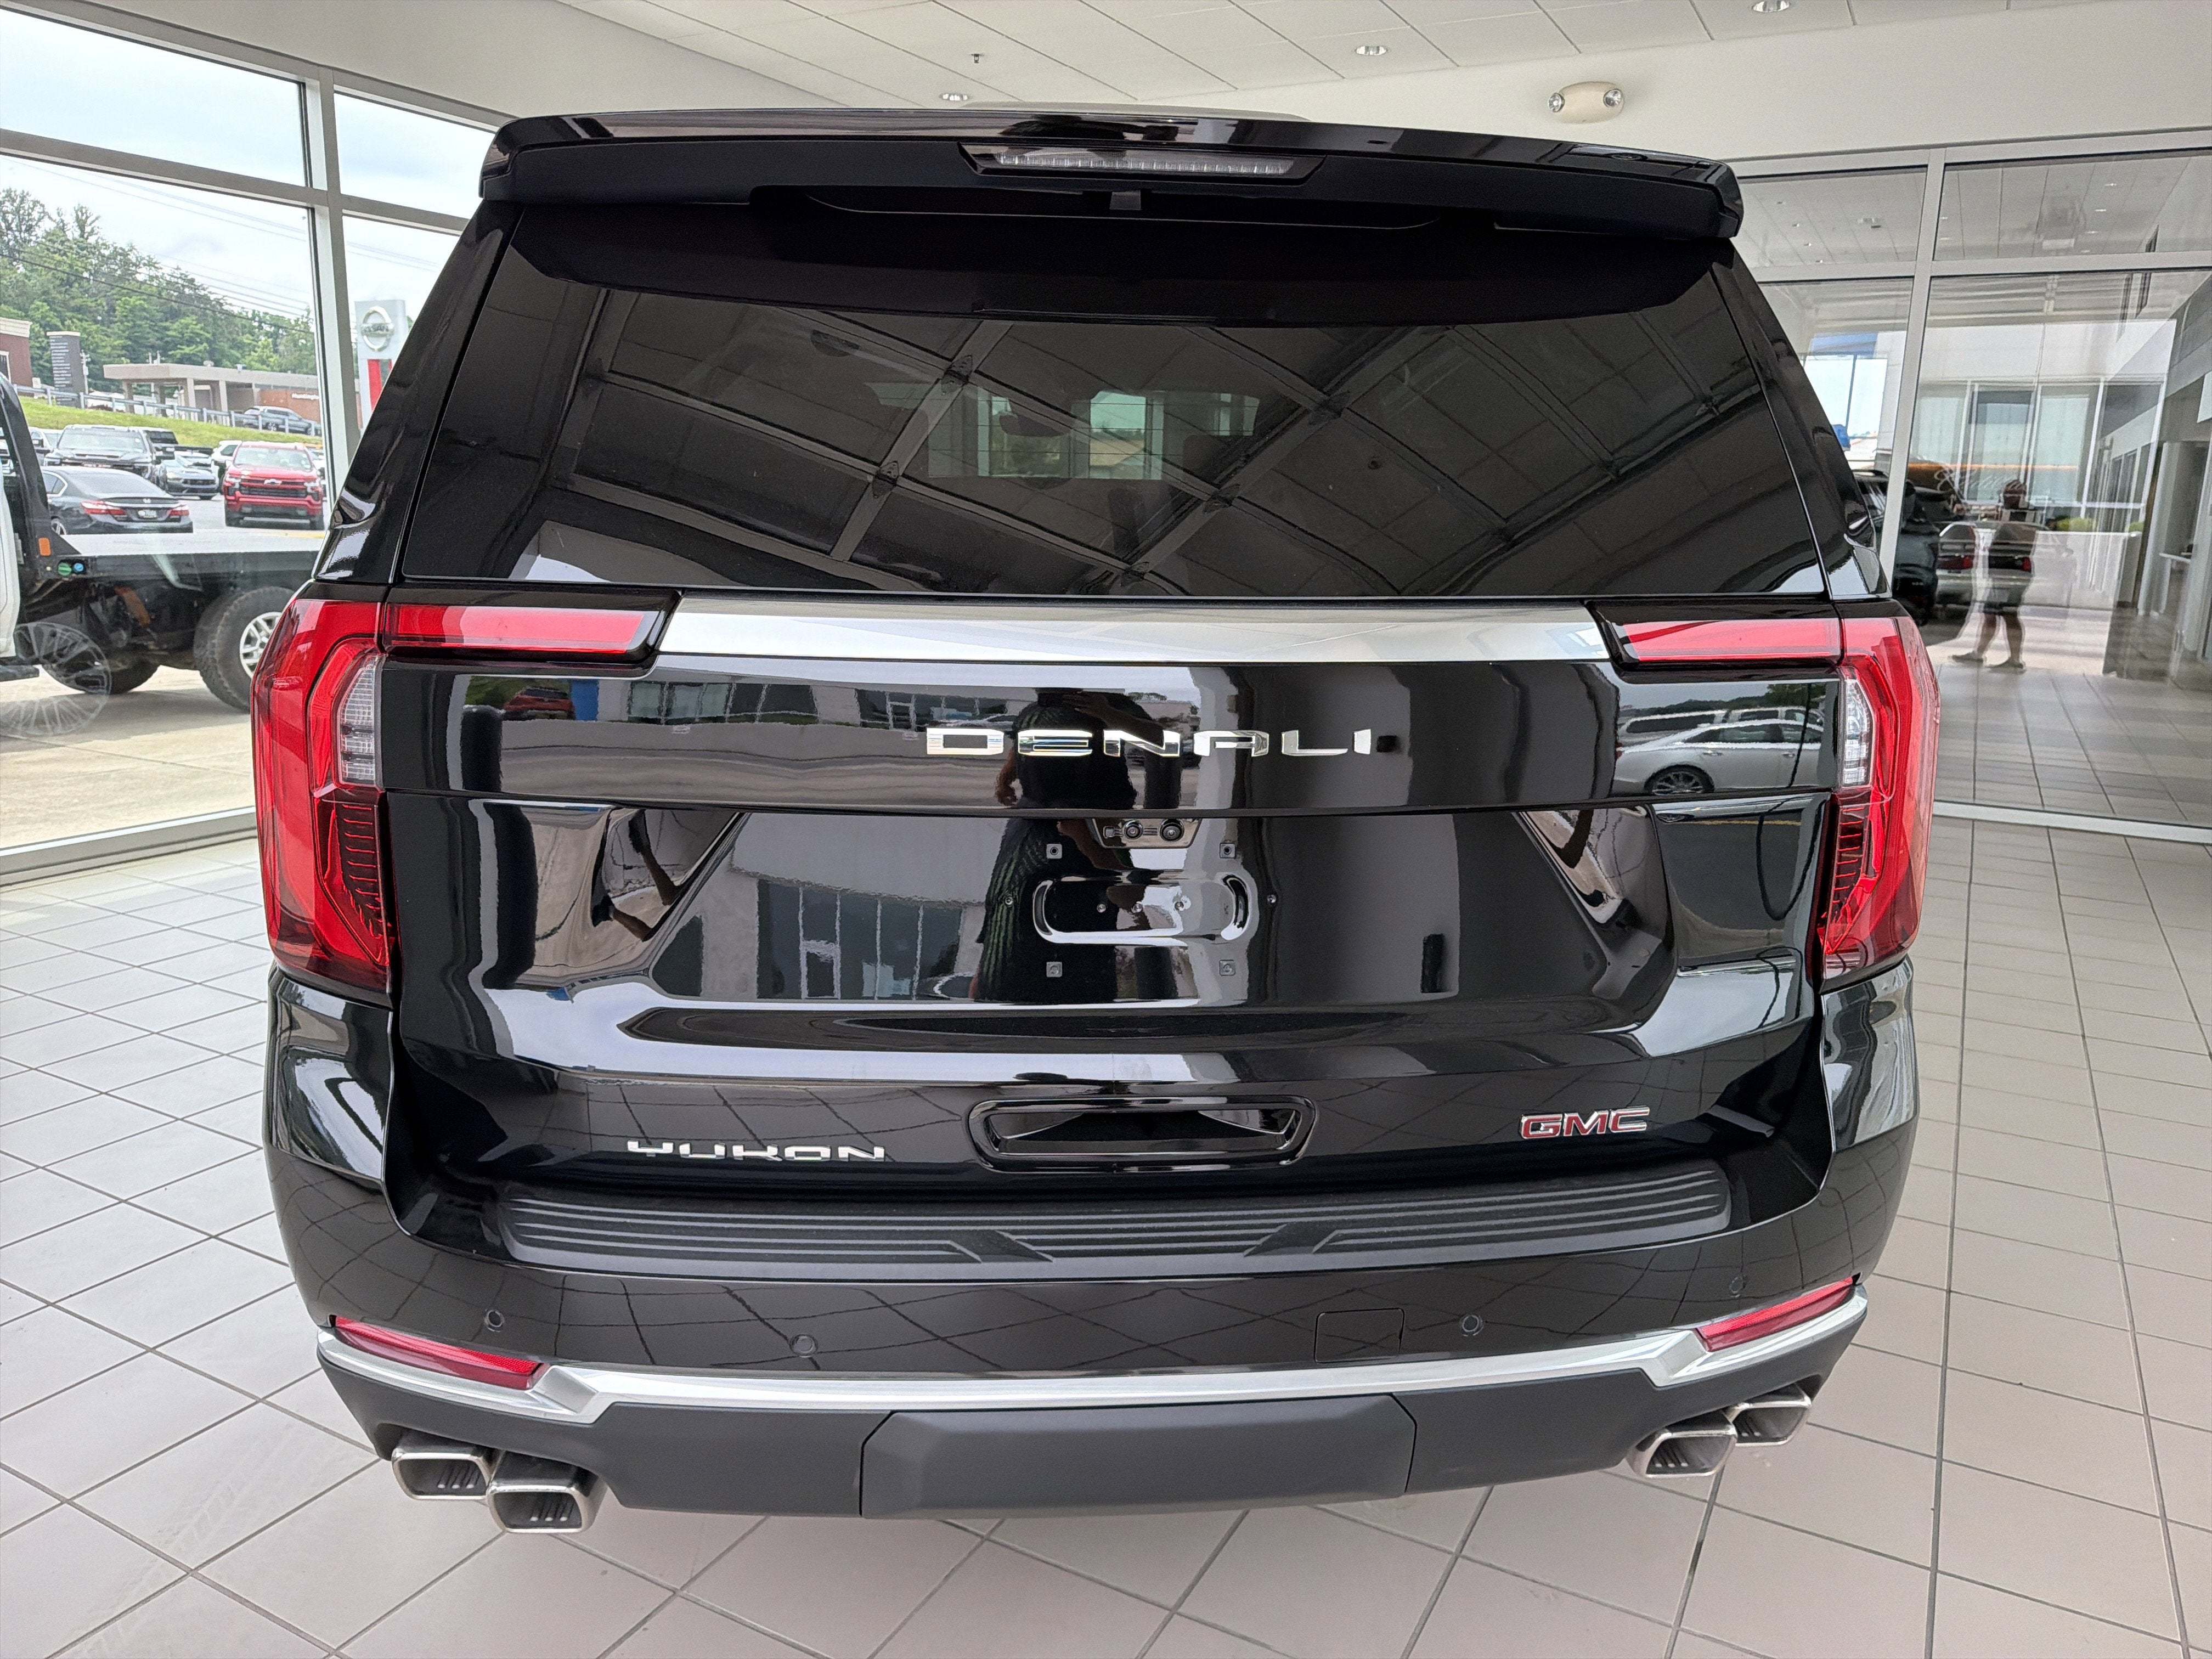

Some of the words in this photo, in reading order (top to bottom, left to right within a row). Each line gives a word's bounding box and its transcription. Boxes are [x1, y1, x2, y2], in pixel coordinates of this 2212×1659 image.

[927, 727, 1372, 757] DENALI
[1520, 1105, 1650, 1139] GMC
[628, 1140, 885, 1162] YUKON
